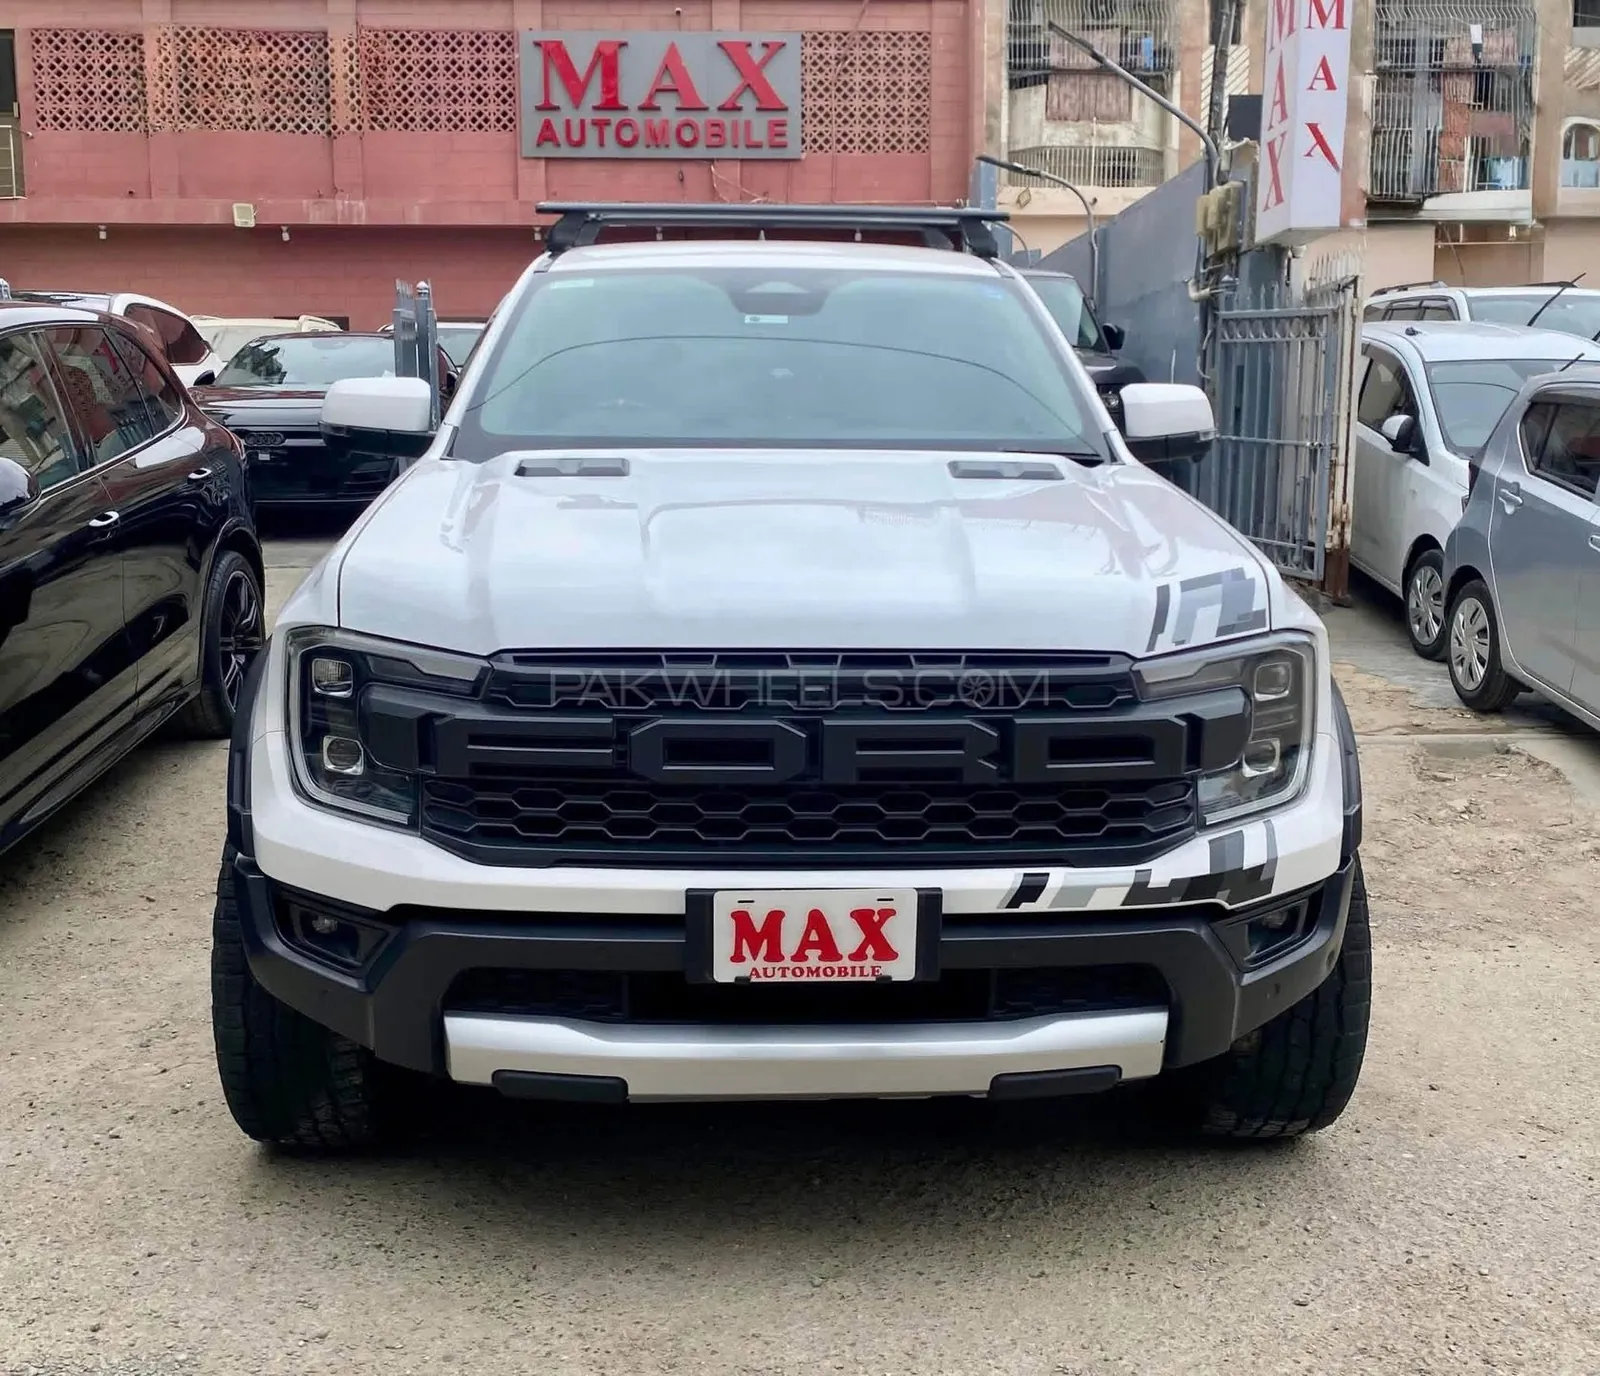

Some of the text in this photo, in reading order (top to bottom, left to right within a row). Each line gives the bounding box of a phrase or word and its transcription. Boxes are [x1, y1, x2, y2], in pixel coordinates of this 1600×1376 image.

[533, 40, 789, 111] MAX
[536, 118, 788, 148] AUTOMOBILE
[434, 714, 1188, 785] FORD
[730, 908, 899, 963] MAX
[749, 965, 883, 979] AUTOMOBILE
